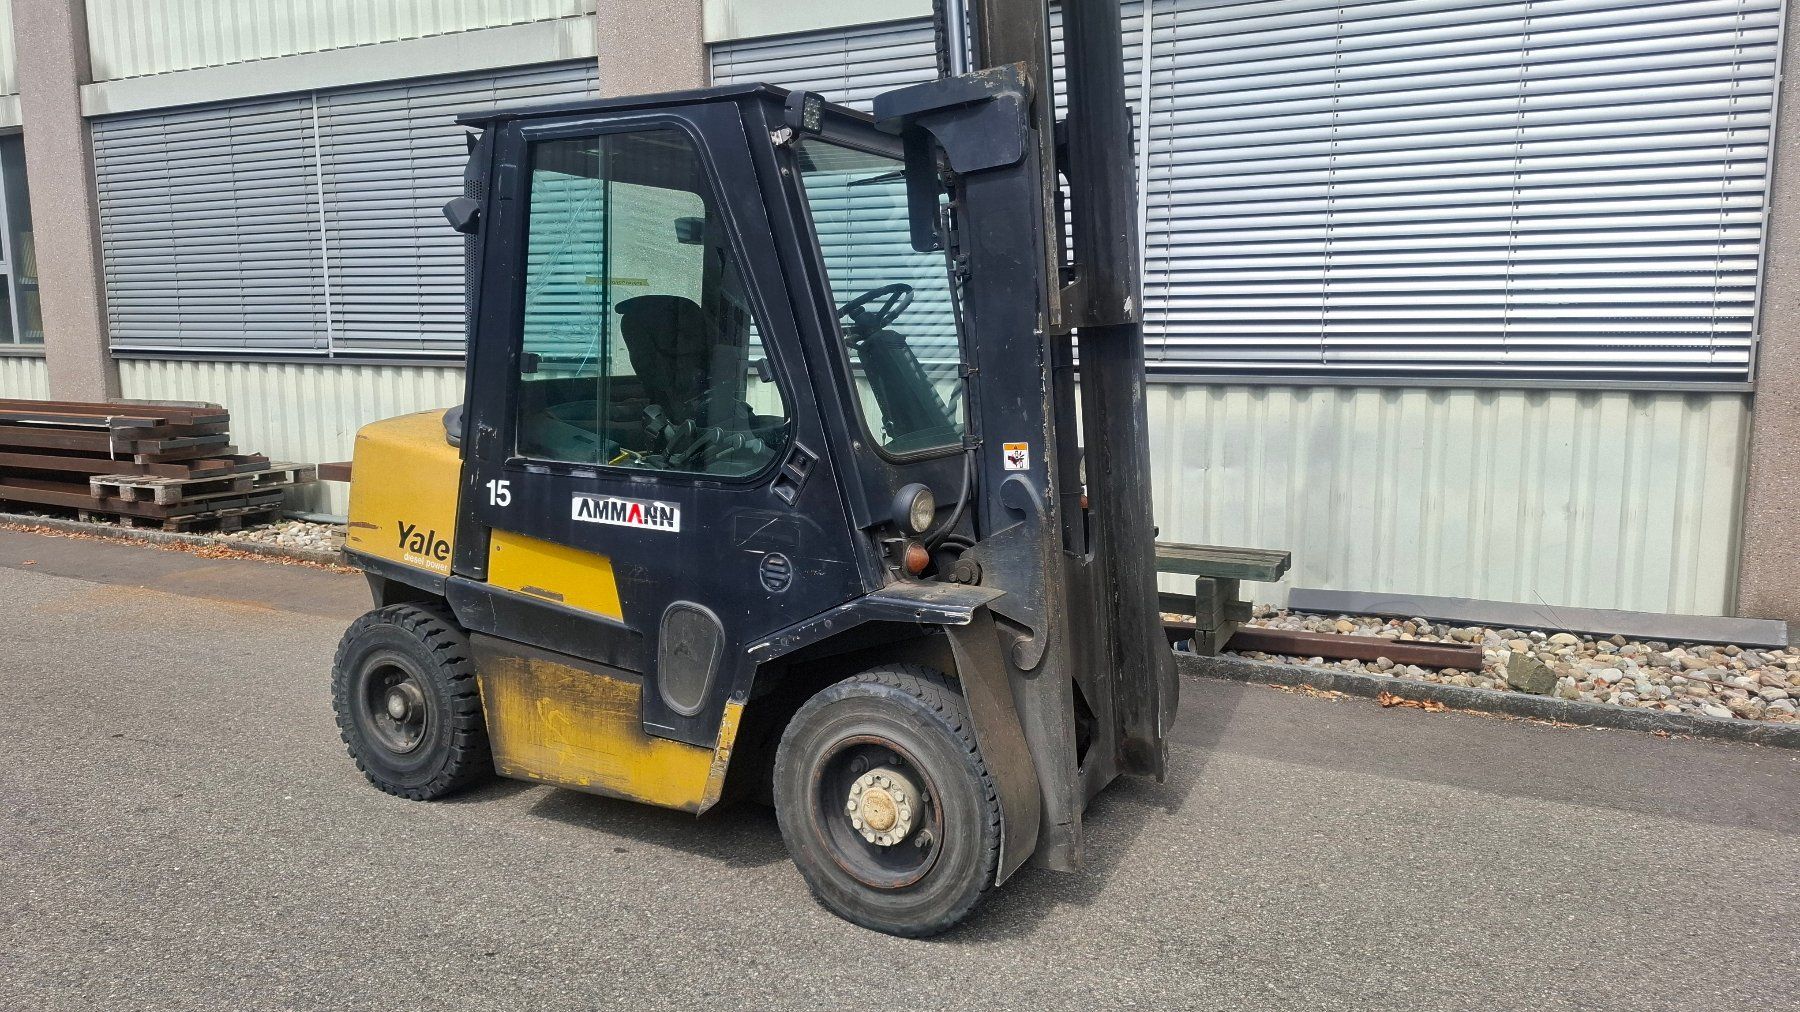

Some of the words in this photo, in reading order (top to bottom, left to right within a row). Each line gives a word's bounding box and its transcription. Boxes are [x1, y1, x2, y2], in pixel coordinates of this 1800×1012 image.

[486, 479, 512, 507] 15
[578, 498, 674, 528] AMMANN
[398, 520, 450, 561] Yale
[403, 552, 425, 565] diesel
[425, 559, 448, 572] power
